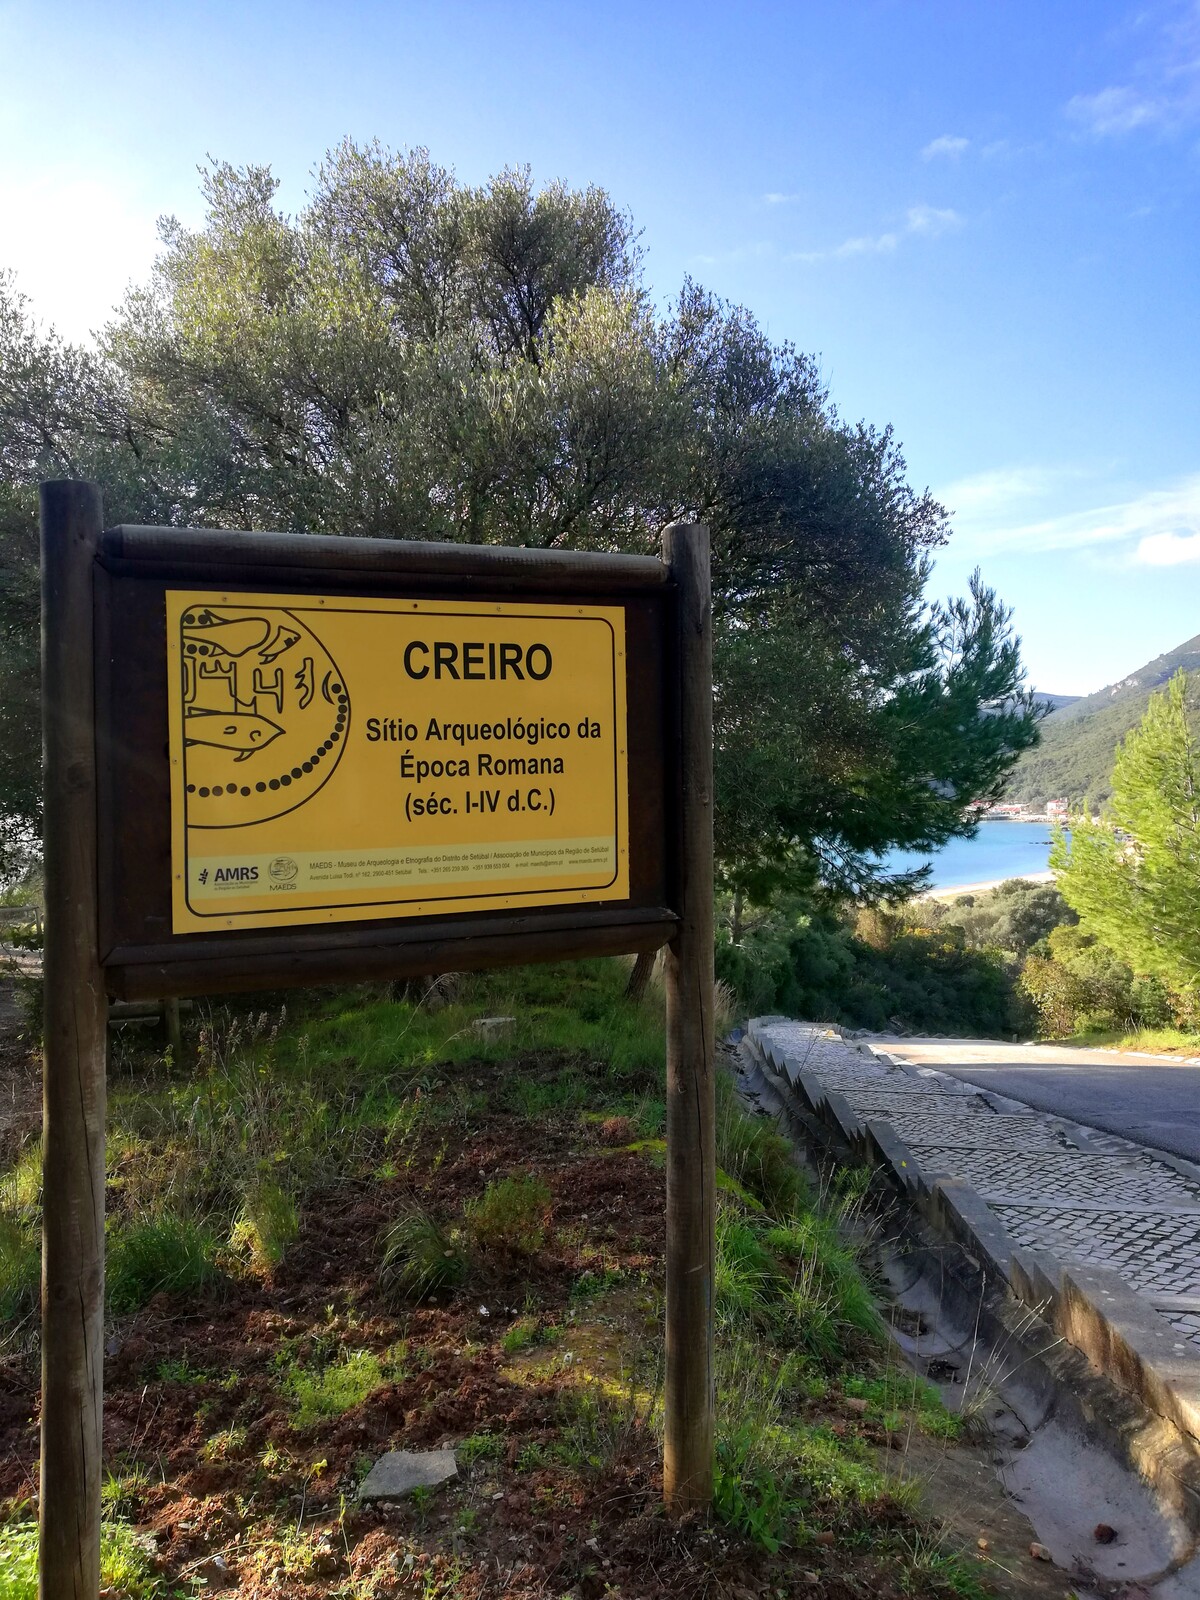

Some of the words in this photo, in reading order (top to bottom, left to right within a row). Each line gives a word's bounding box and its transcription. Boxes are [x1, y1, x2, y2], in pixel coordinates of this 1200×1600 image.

[404, 641, 553, 681] CREIRO
[366, 718, 418, 741] Sítio
[425, 717, 571, 746] Arqueológico
[577, 717, 601, 739] da
[400, 749, 470, 783] Época
[478, 754, 564, 776] Romana
[405, 793, 458, 822] (séc.
[466, 790, 500, 813] I-IV
[507, 788, 556, 816] d.C.)
[214, 866, 259, 882] AMRS
[310, 861, 333, 870] MAEDS
[338, 860, 357, 868] Museu
[270, 883, 297, 891] MAEDS
